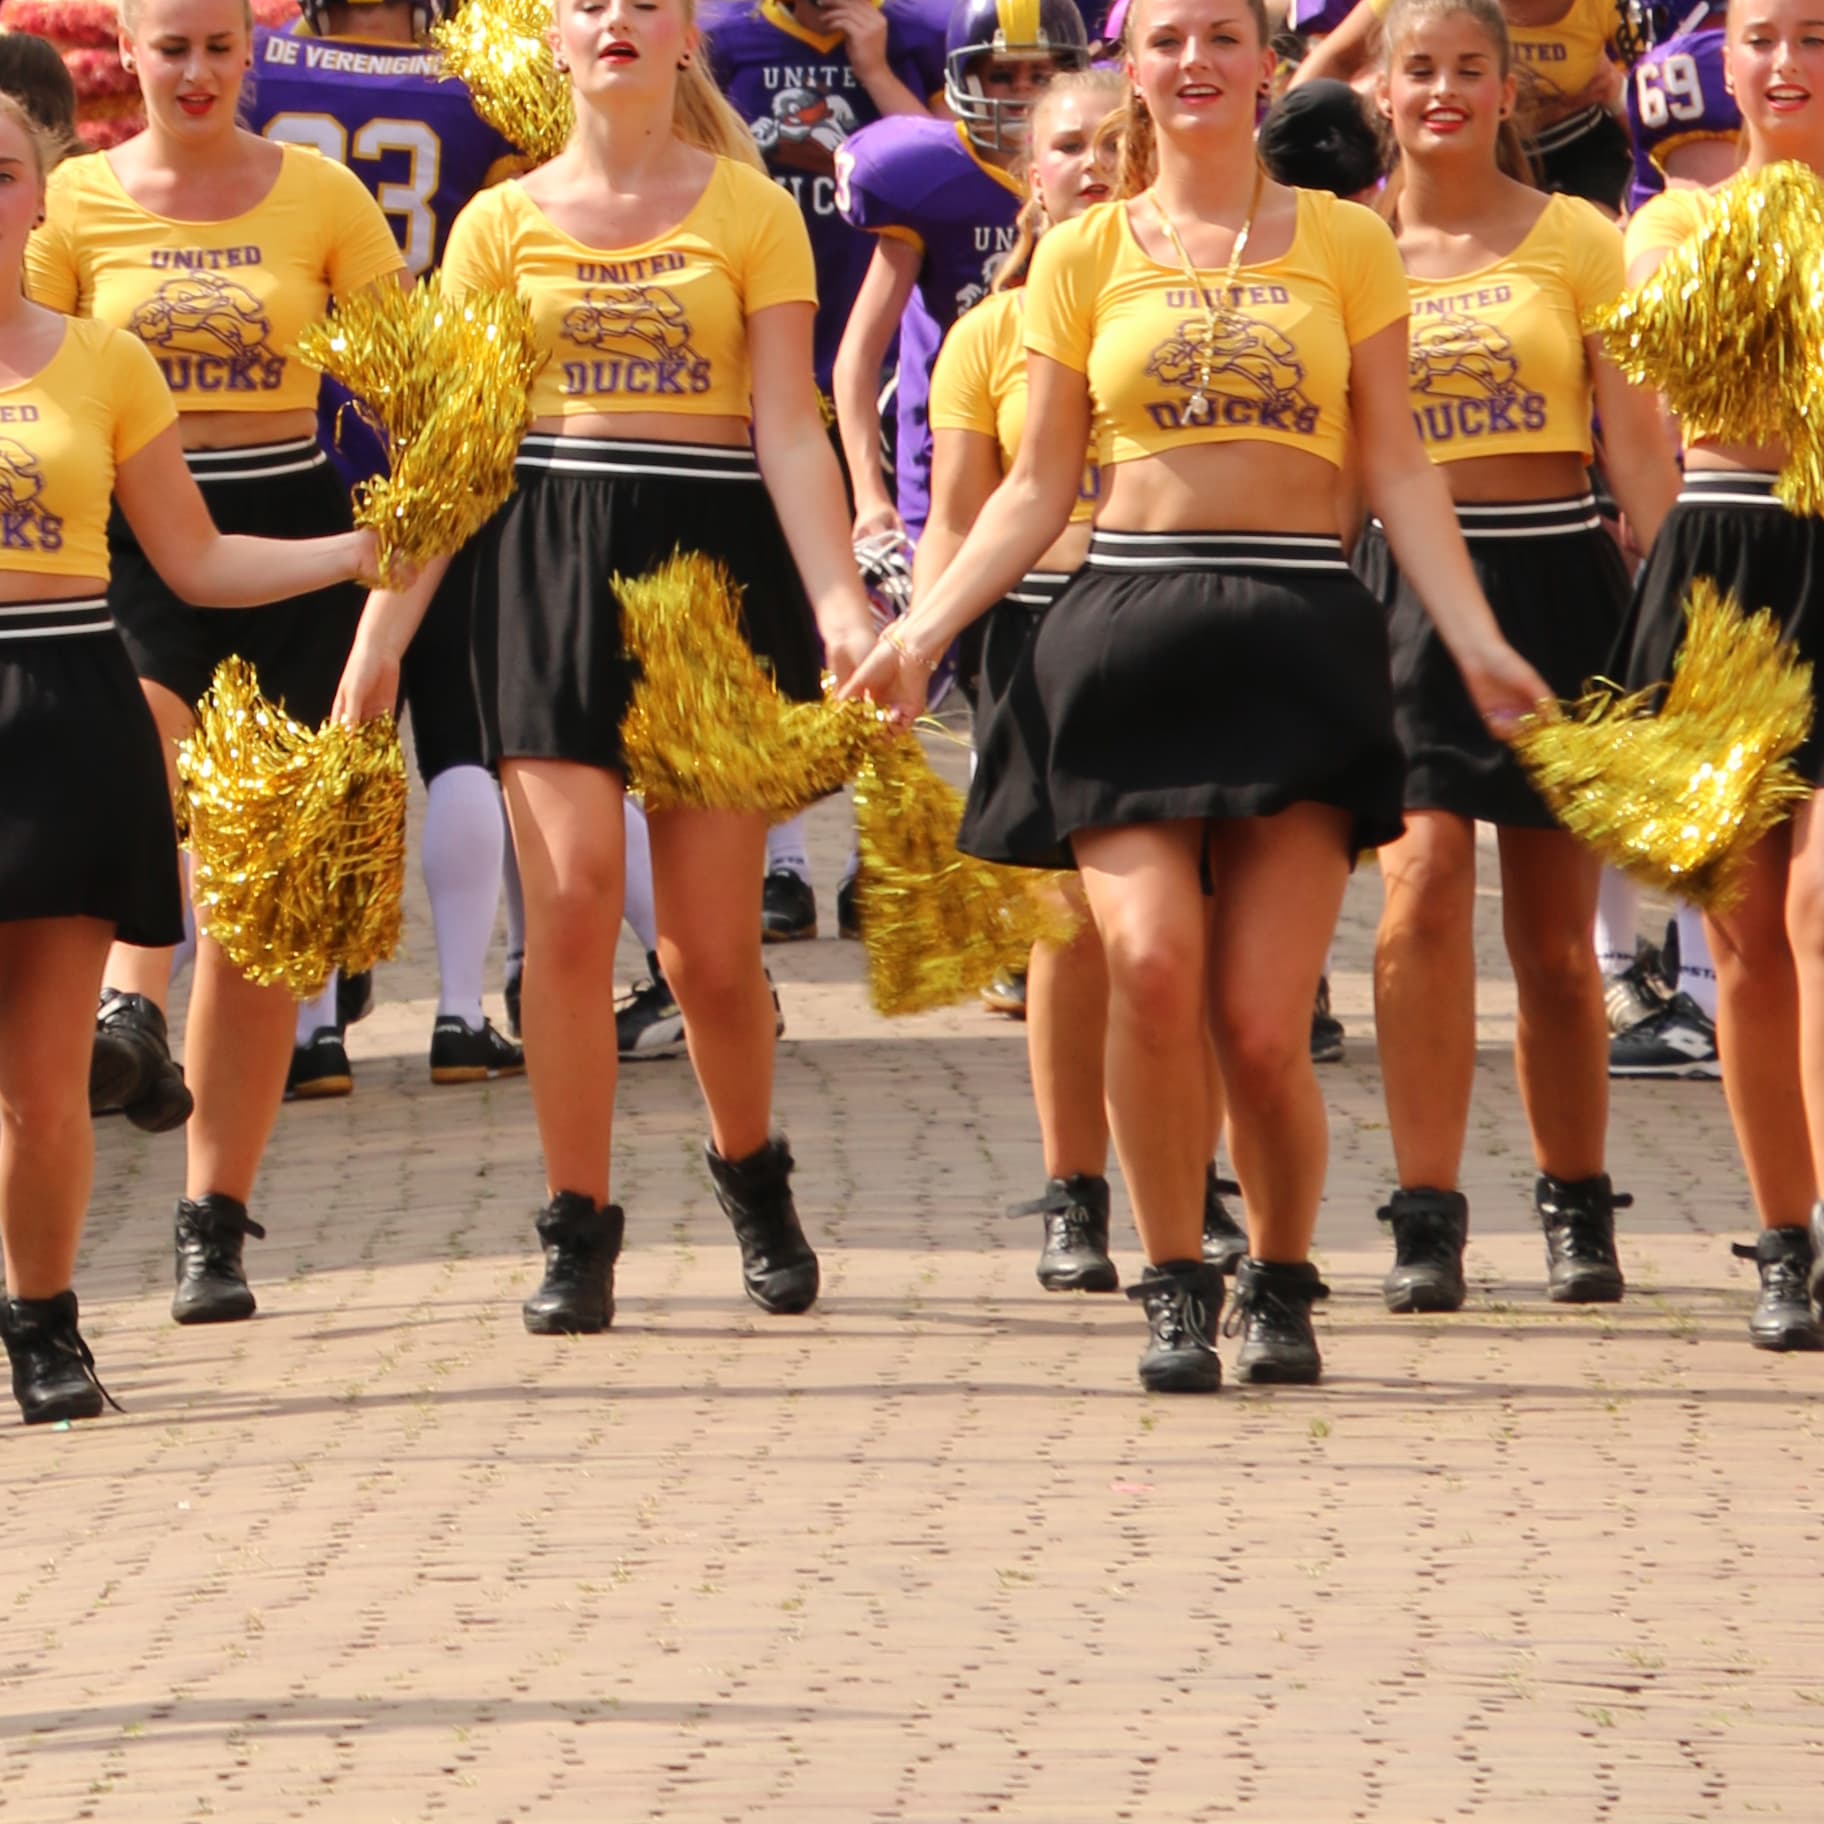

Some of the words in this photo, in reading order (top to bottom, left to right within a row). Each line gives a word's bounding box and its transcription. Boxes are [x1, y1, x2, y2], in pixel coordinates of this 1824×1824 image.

[264, 37, 299, 63] DE
[763, 65, 857, 89] UNITE
[1636, 54, 1705, 129] 69
[151, 245, 262, 270] UNITED
[577, 253, 685, 284] UNITED
[160, 355, 287, 392] UCKS
[563, 358, 711, 396] DUCKS
[1145, 395, 1319, 434] DUCKS
